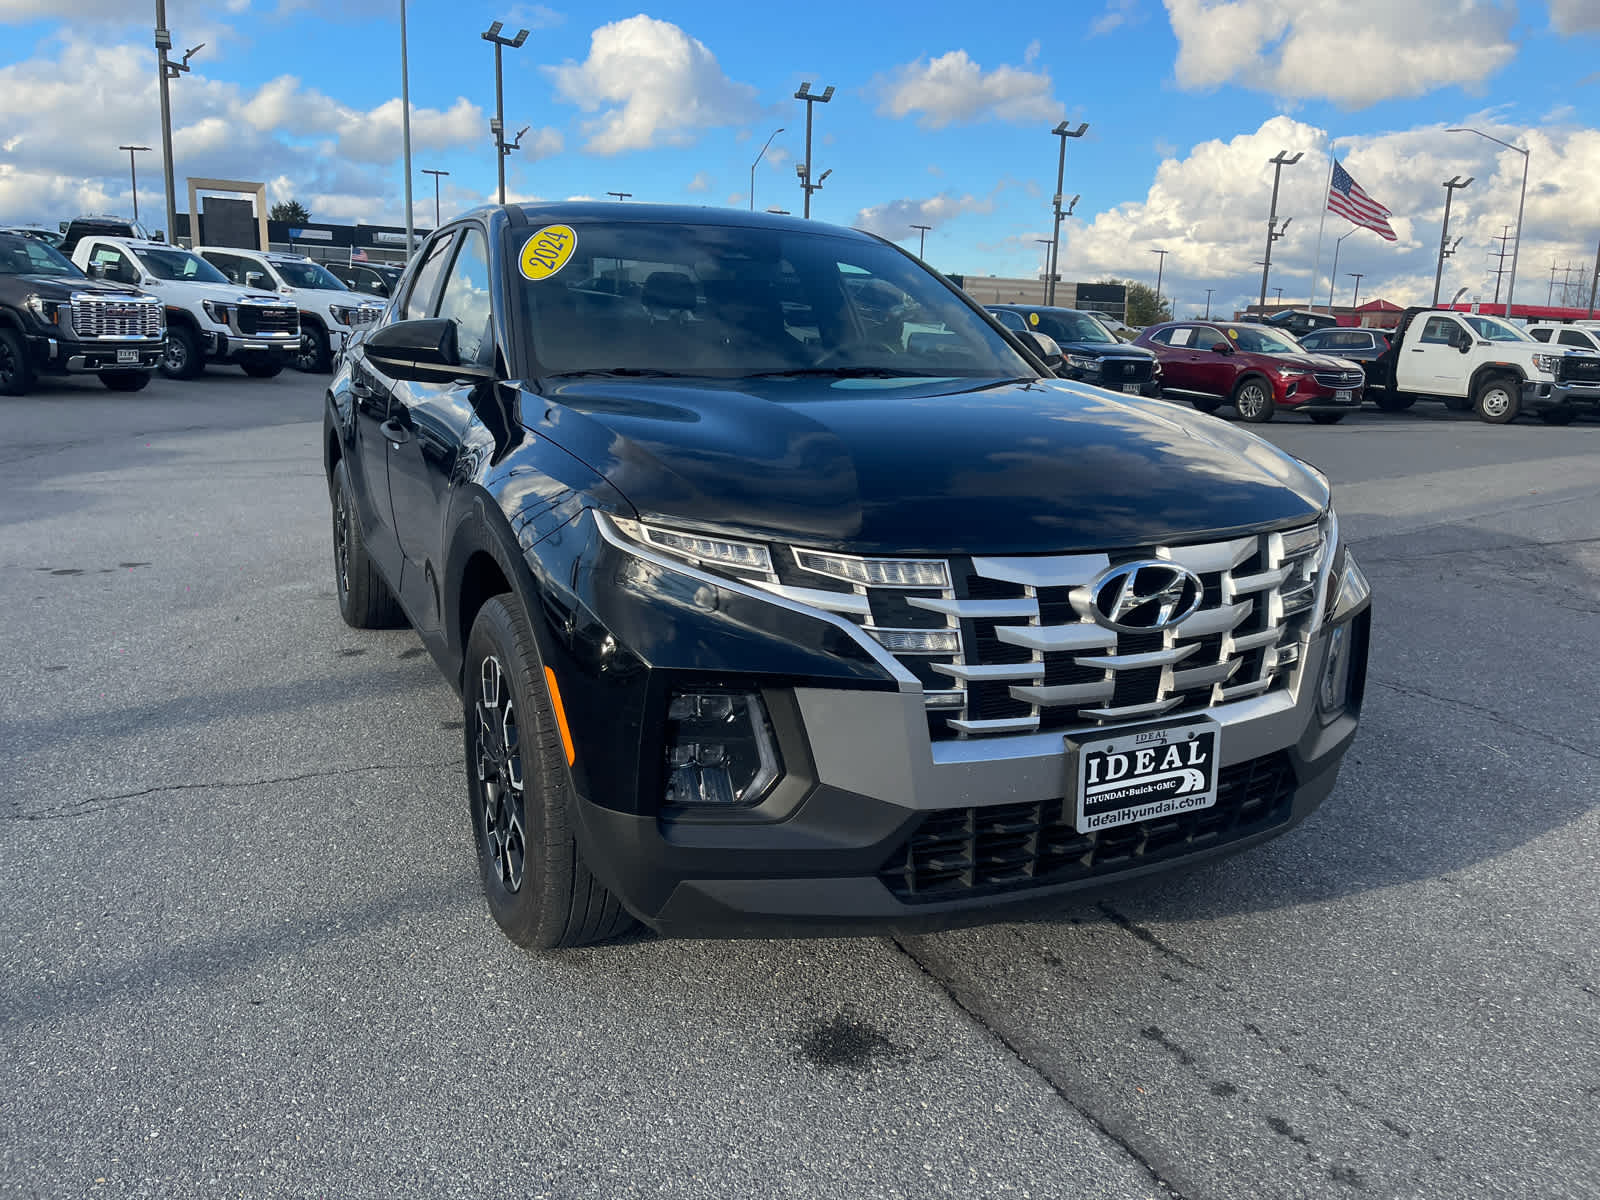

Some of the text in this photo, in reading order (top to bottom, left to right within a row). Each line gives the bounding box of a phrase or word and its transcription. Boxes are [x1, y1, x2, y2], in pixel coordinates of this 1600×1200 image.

[529, 231, 569, 270] 2024
[1136, 730, 1168, 741] IDEAL
[1087, 741, 1207, 784] IDEAL
[1087, 796, 1207, 828] IdealHyundai.com
